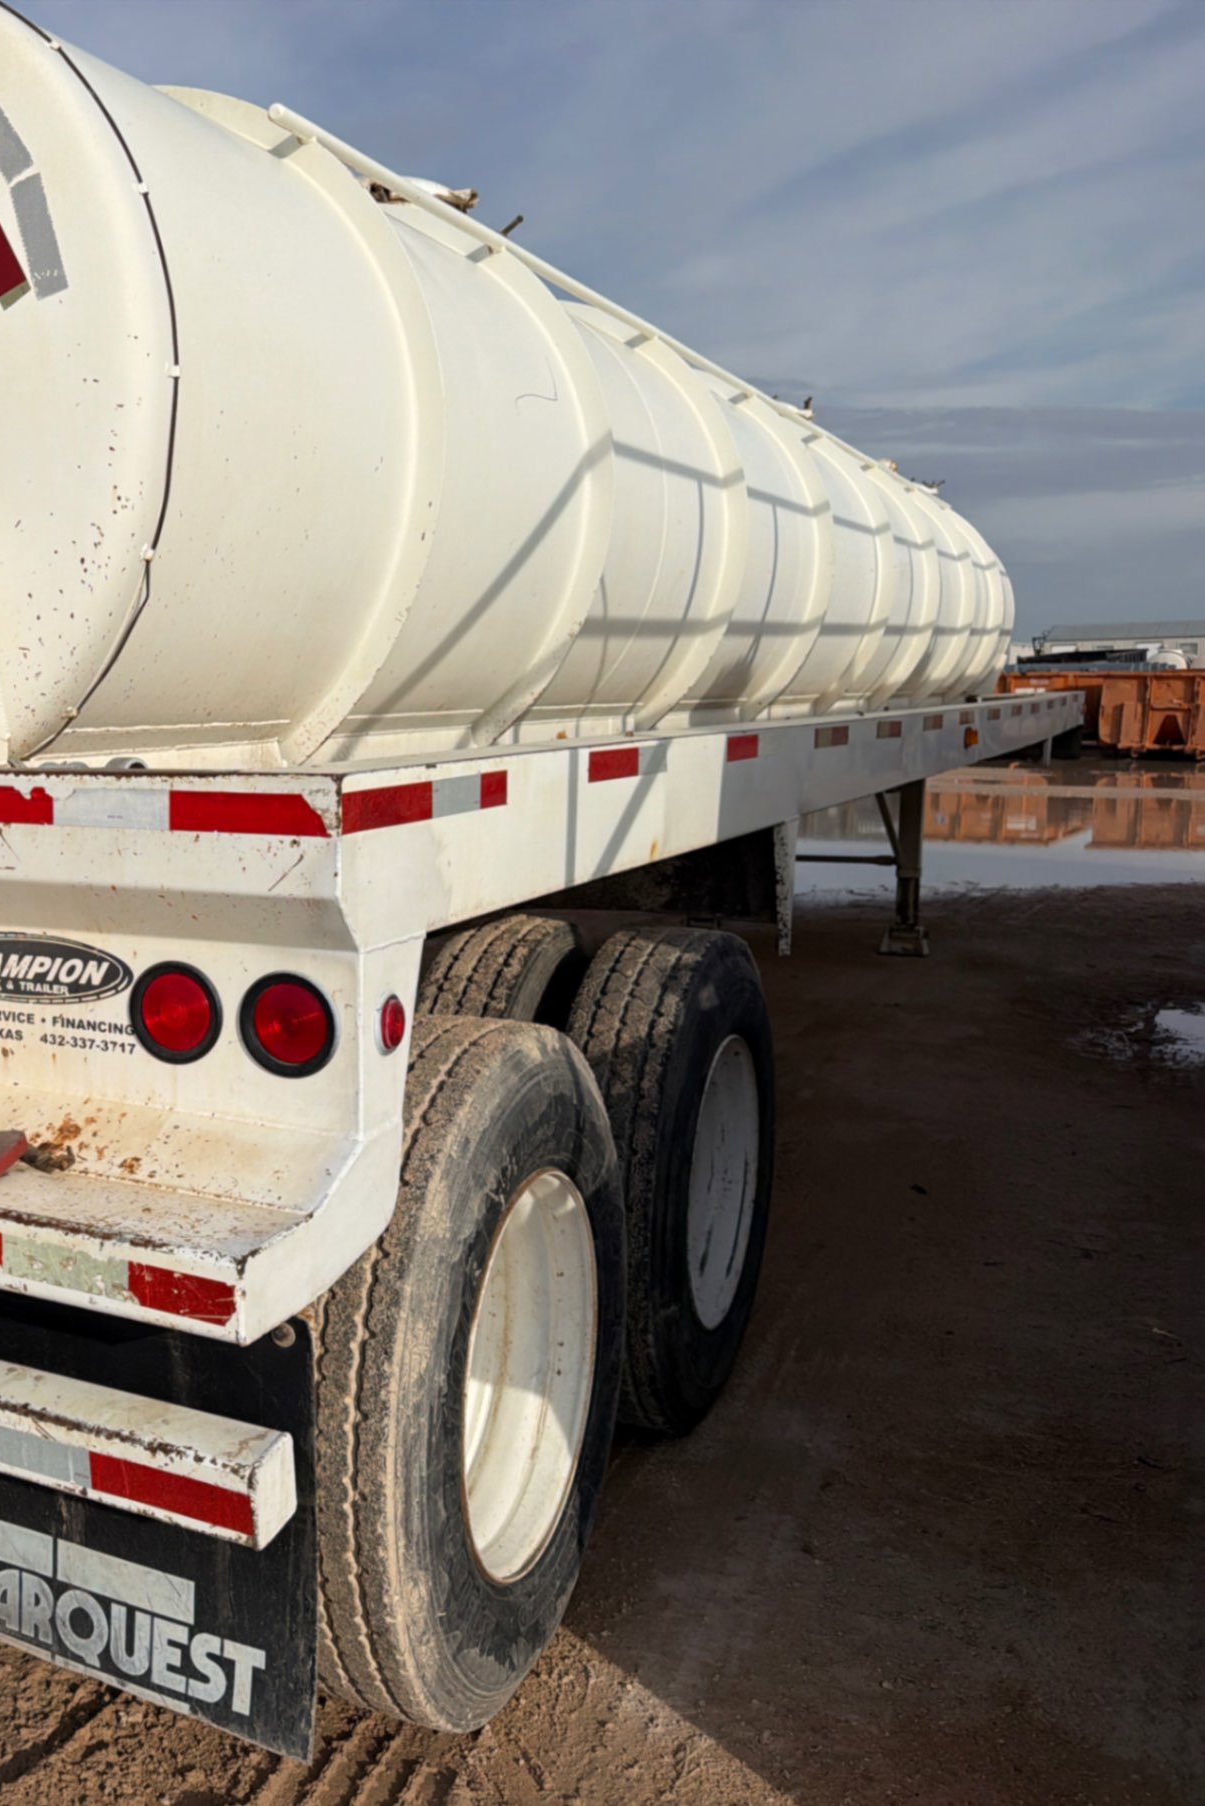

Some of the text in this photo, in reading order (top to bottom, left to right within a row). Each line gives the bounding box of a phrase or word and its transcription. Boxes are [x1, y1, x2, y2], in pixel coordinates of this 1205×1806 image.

[6, 980, 15, 990] &
[19, 981, 69, 996] TRAILER
[51, 1016, 135, 1036] FINANCING
[40, 1034, 136, 1055] 432-337-3717
